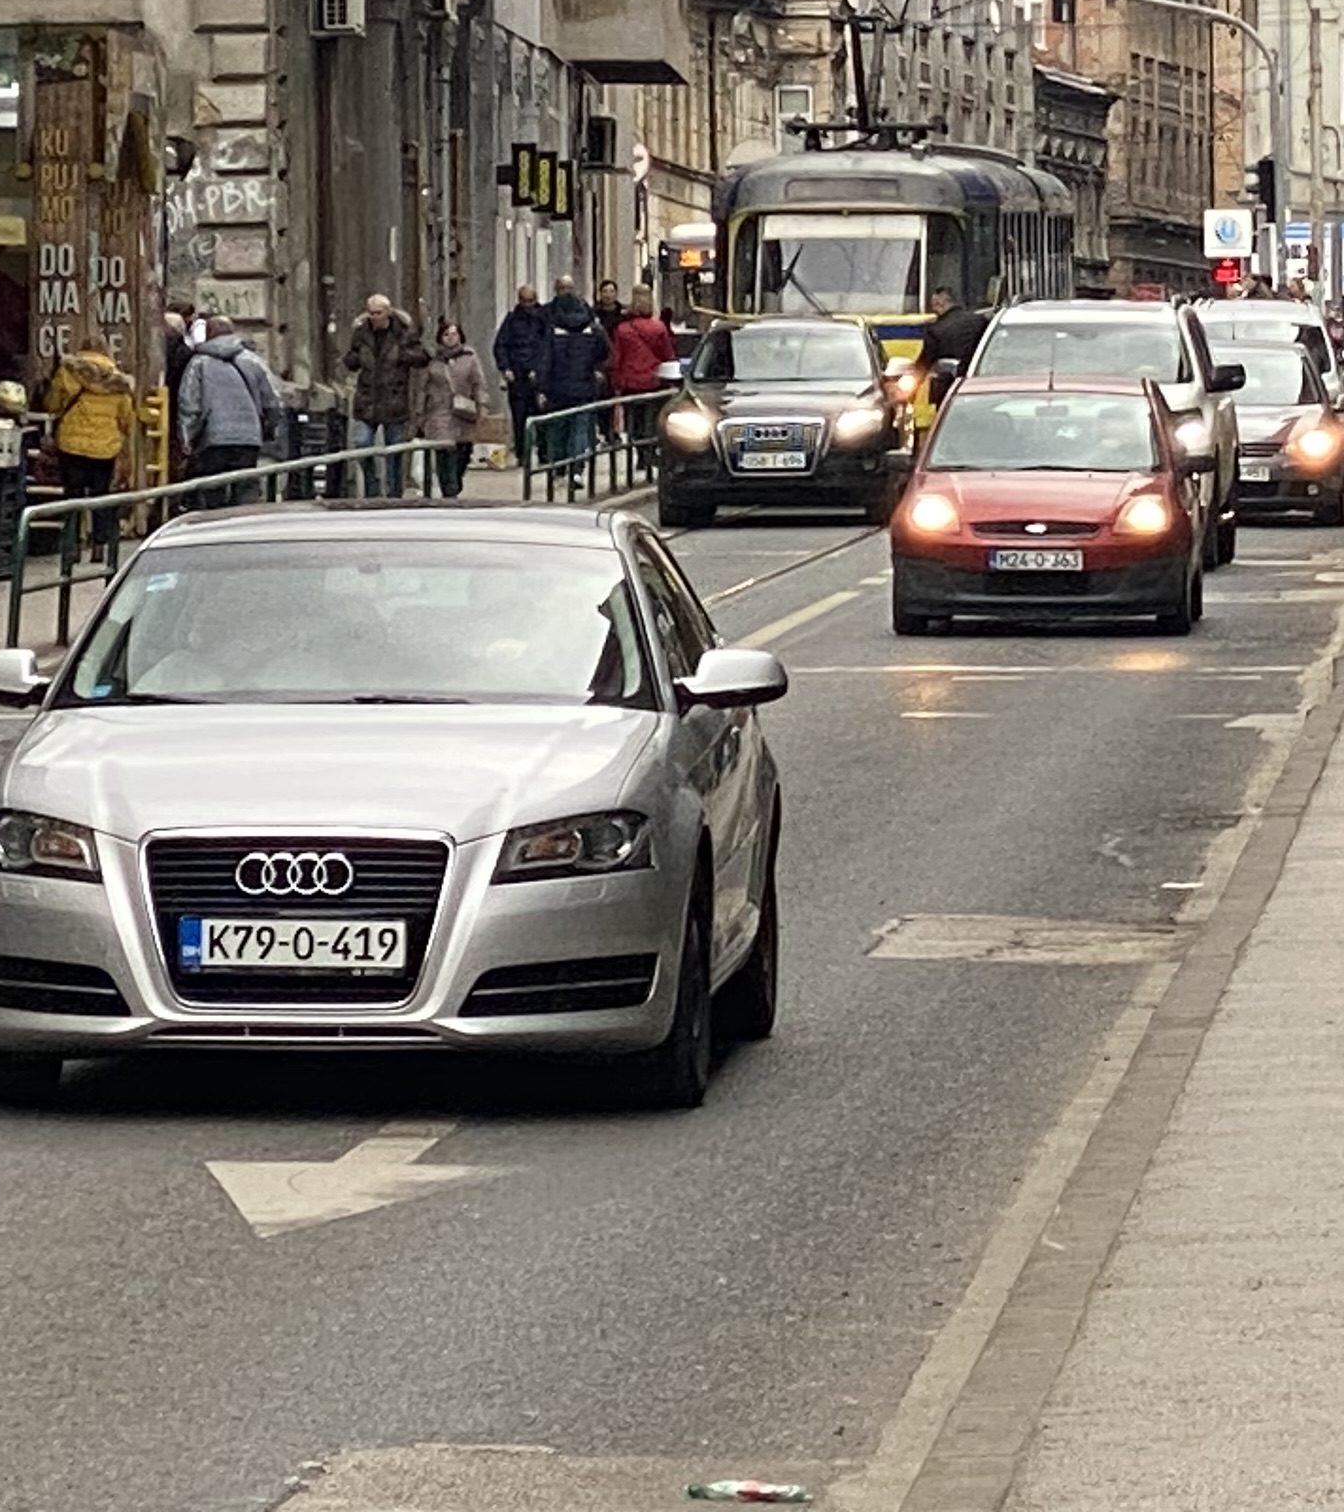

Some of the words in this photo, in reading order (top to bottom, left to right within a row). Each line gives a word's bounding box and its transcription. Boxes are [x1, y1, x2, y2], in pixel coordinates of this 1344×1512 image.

[39, 243, 76, 278] DO
[39, 280, 81, 316] MA
[39, 318, 72, 359] ĆE
[208, 924, 399, 962] K79-O-419
